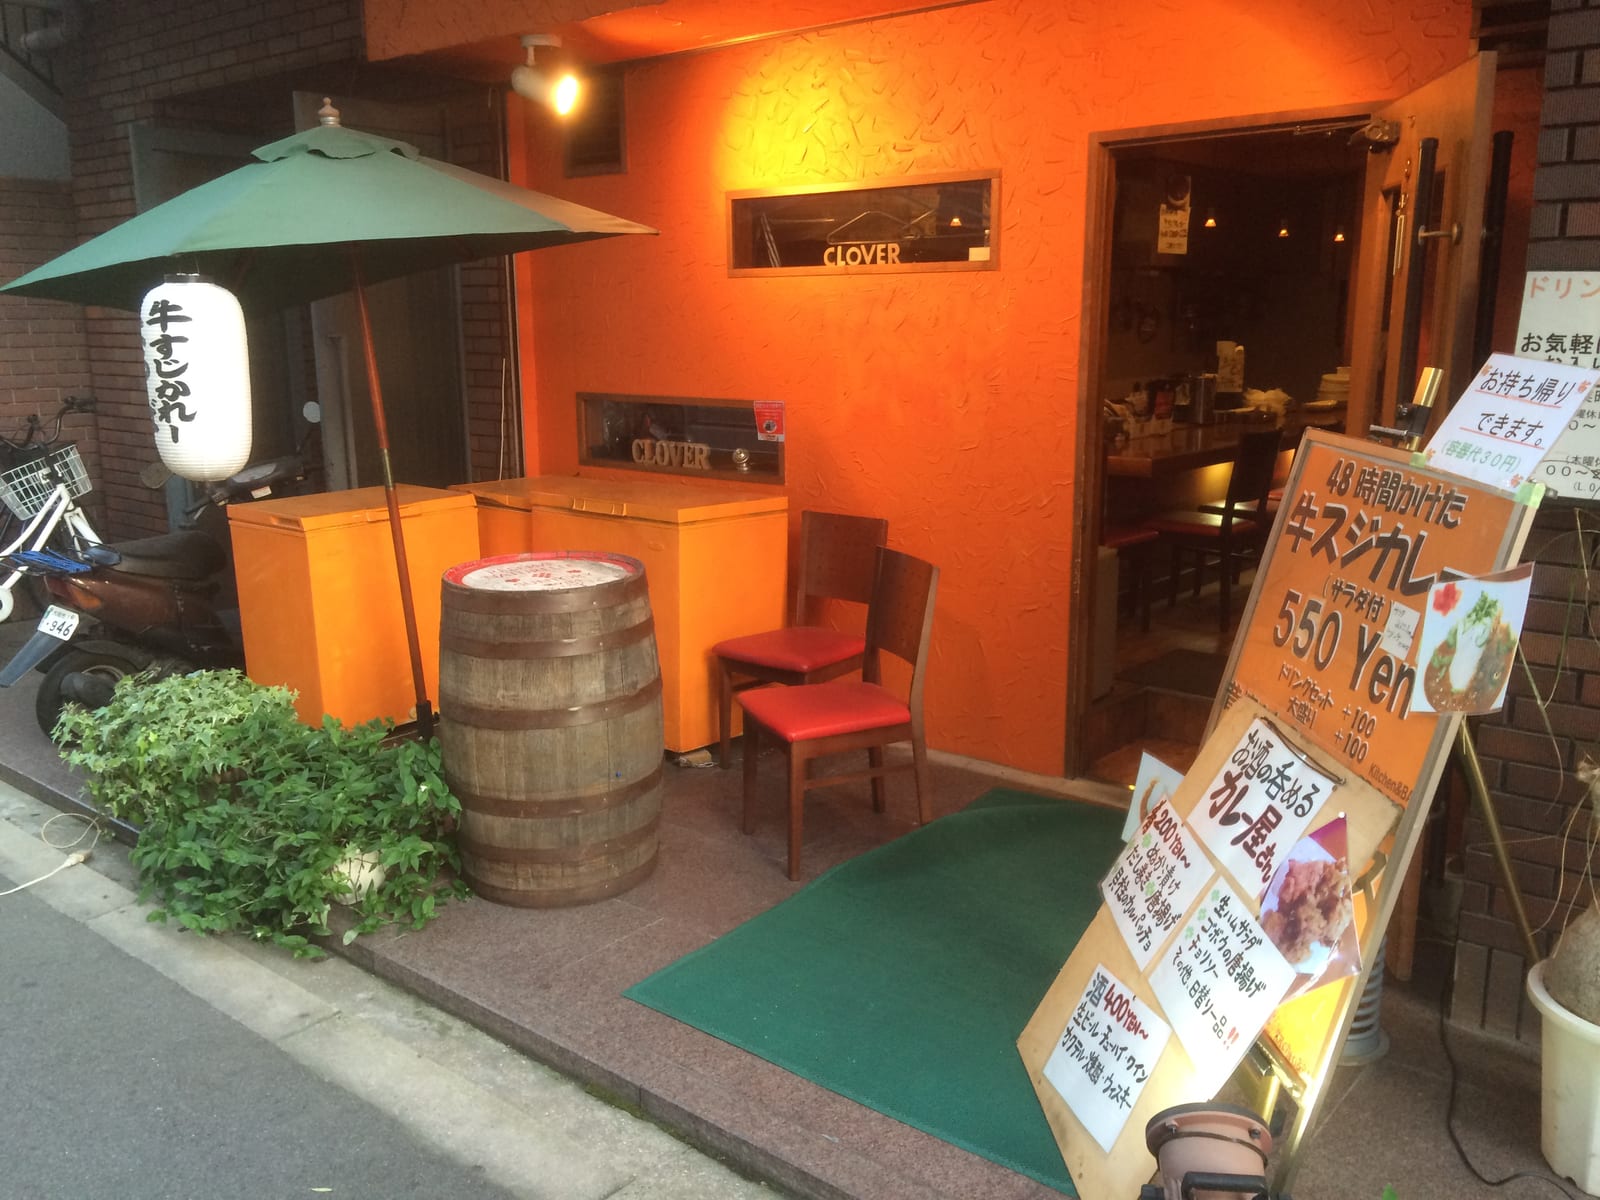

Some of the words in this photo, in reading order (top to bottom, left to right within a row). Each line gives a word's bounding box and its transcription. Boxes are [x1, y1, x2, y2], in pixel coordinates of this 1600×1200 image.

[823, 243, 900, 266] CLOVER
[146, 299, 198, 444] 牛すじかれー
[1480, 368, 1577, 405] お持ち帰り
[631, 438, 711, 470] CLOVER
[1477, 412, 1545, 447] できます。
[1326, 458, 1356, 497] 48
[1353, 466, 1469, 529] 時間かけた
[1273, 588, 1342, 672] 550
[1350, 624, 1416, 721] Yen
[1231, 729, 1320, 818] お酒の呑める
[1209, 770, 1283, 883] カレー屋さん
[1213, 895, 1263, 951] 生ハムサラダ
[1188, 934, 1219, 978] チョリソー
[1201, 917, 1267, 998] ゴボウの唐揚げ
